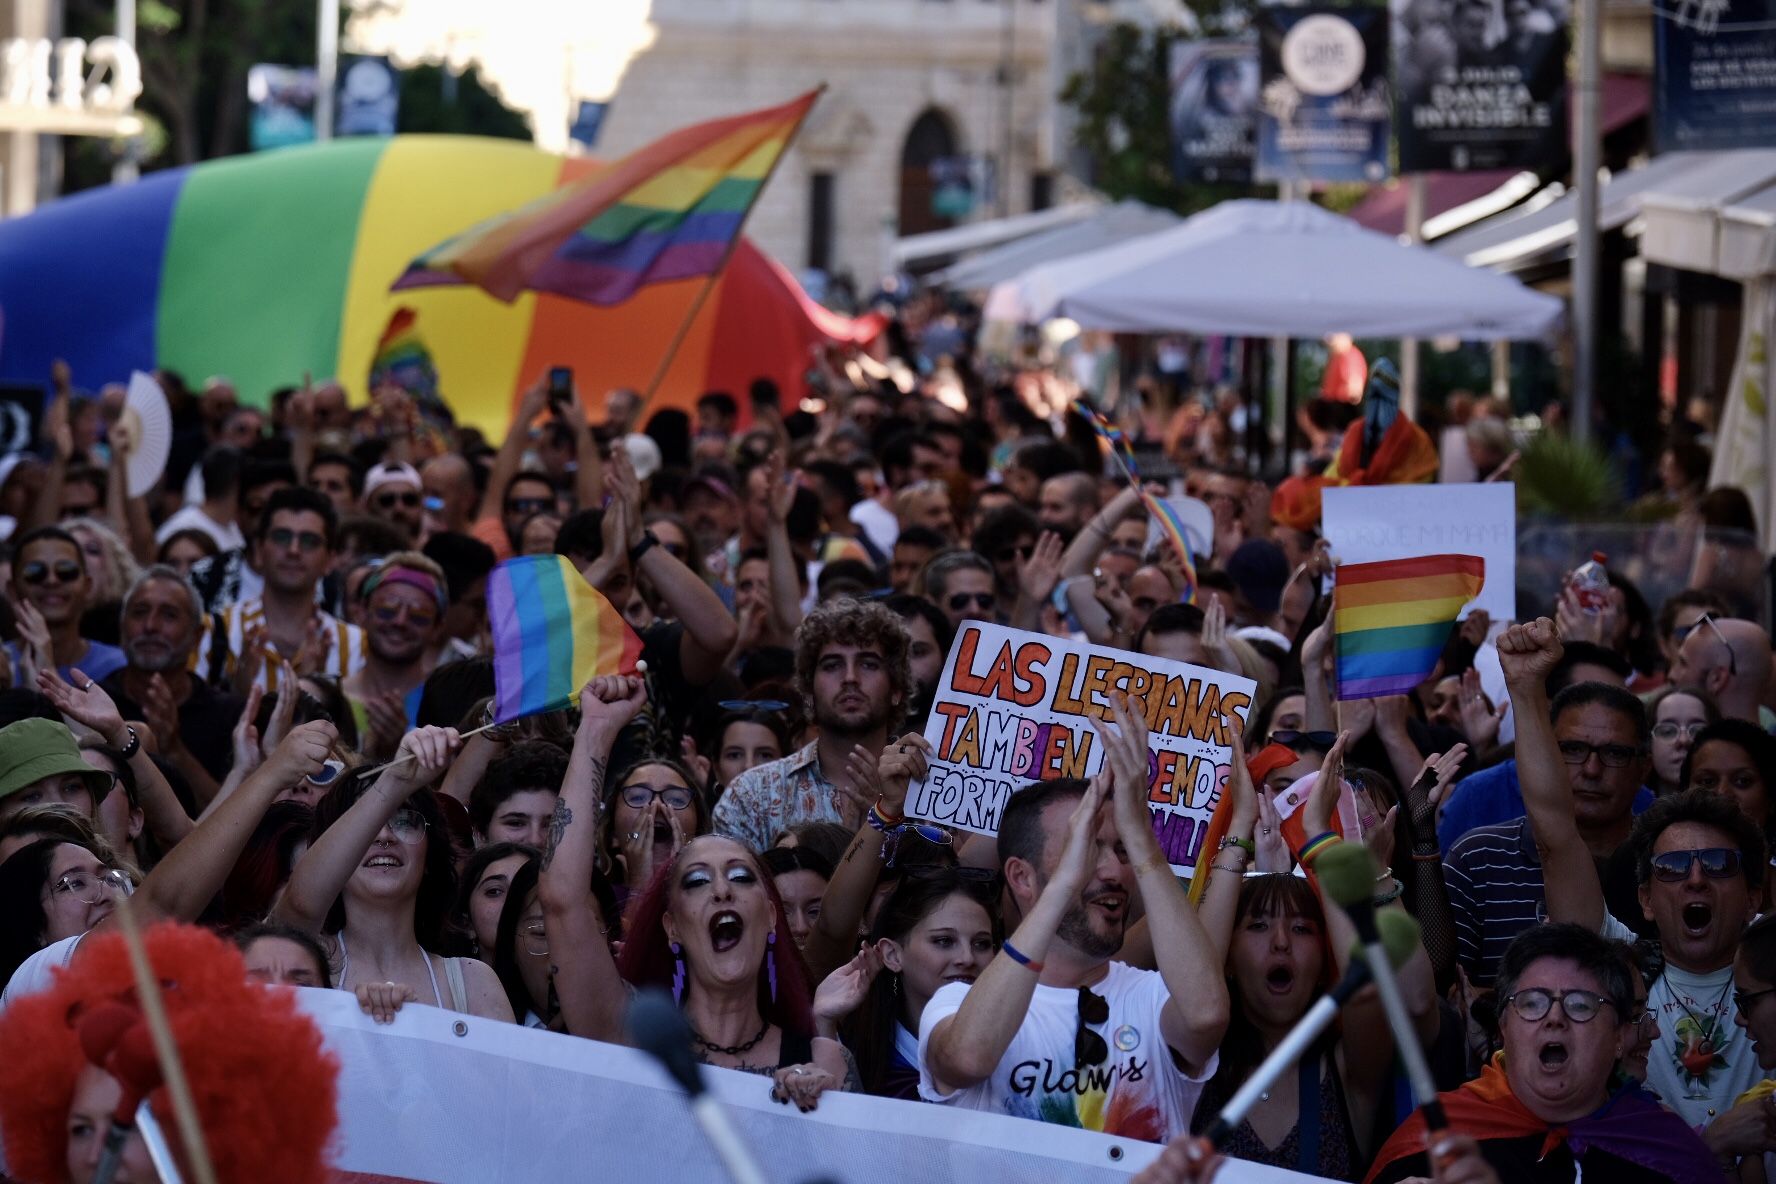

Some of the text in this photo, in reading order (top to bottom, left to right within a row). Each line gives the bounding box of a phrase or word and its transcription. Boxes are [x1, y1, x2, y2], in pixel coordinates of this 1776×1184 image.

[1413, 104, 1551, 127] INVISIBLE
[1431, 83, 1533, 108] DANZA
[951, 627, 1251, 747] LAS LESBIANAS
[935, 702, 1094, 780] TAMBIEN
[915, 765, 1013, 832] FORM
